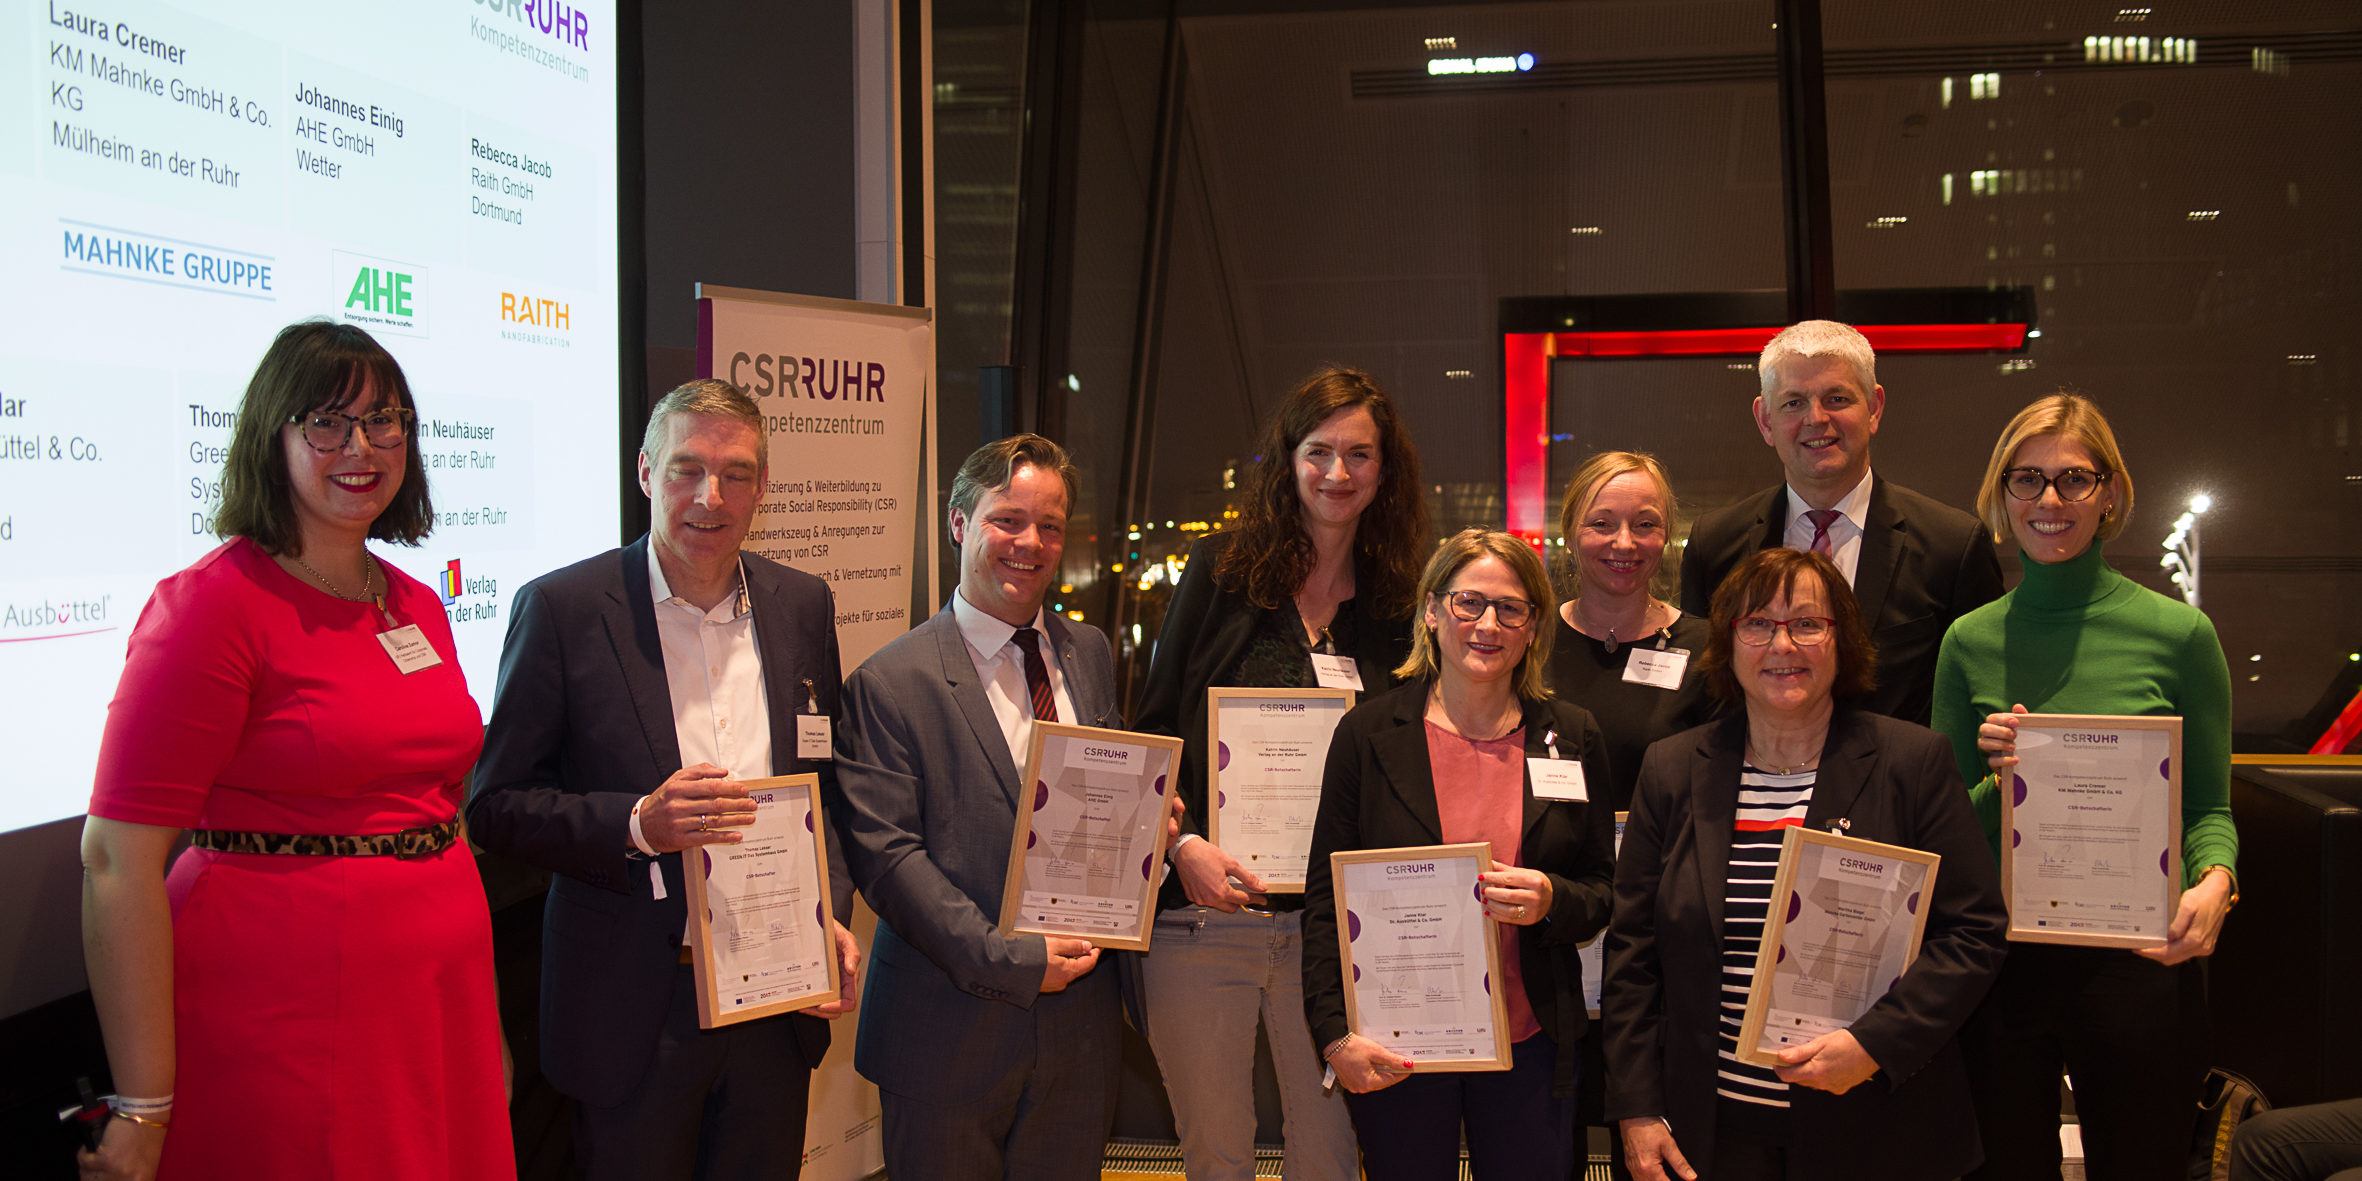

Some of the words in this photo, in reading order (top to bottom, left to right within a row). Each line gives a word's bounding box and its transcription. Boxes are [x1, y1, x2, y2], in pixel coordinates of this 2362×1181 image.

[49, 0, 109, 41] Laura
[116, 23, 186, 65] Cremer
[471, 15, 589, 84] Kompetenzzentrum
[50, 40, 83, 73] KM
[91, 53, 164, 96] Mahnke
[170, 78, 223, 114] GmbH
[229, 96, 240, 118] &
[246, 101, 272, 128] Co.
[51, 80, 83, 111] KG
[295, 82, 366, 121] Johannes
[370, 105, 404, 138] Einig
[296, 115, 328, 144] AHE
[332, 126, 374, 157] GmbH
[53, 120, 134, 164] Mülheim
[141, 149, 162, 170] an
[169, 151, 196, 177] der
[202, 158, 240, 188] Ruhr
[296, 148, 342, 180] Wetter
[471, 138, 518, 169] Rebecca
[521, 154, 552, 179] Jacob
[472, 167, 499, 192] Raith
[502, 176, 534, 201] GmbH
[472, 196, 522, 225] Dortmund
[64, 230, 175, 276] MAHNKE
[184, 252, 272, 291] GRUPPE
[345, 266, 413, 317] AHE
[501, 292, 569, 330] RAITH
[433, 419, 494, 440] Neuhäuser
[49, 435, 62, 460] &
[70, 437, 102, 462] Co.
[432, 453, 446, 468] an
[450, 449, 467, 468] der
[470, 450, 496, 469] Ruhr
[806, 480, 812, 493] &
[814, 480, 870, 494] Weiterbildung
[872, 482, 882, 492] zu
[445, 512, 458, 526] an
[462, 508, 479, 526] der
[482, 507, 507, 526] Ruhr
[789, 500, 815, 513] Social
[817, 499, 873, 515] Responsibility
[874, 498, 897, 511] (CSR)
[813, 525, 819, 537] &
[821, 525, 870, 539] Anregungen
[872, 524, 885, 534] zur
[794, 546, 809, 557] von
[812, 545, 829, 557] CSR
[466, 575, 497, 598] Verlag
[834, 569, 839, 581] &
[842, 566, 887, 580] Vernetzung
[889, 564, 901, 577] mit
[456, 604, 472, 622] der
[475, 603, 497, 620] Ruhr
[862, 610, 874, 622] für
[876, 608, 904, 620] soziales
